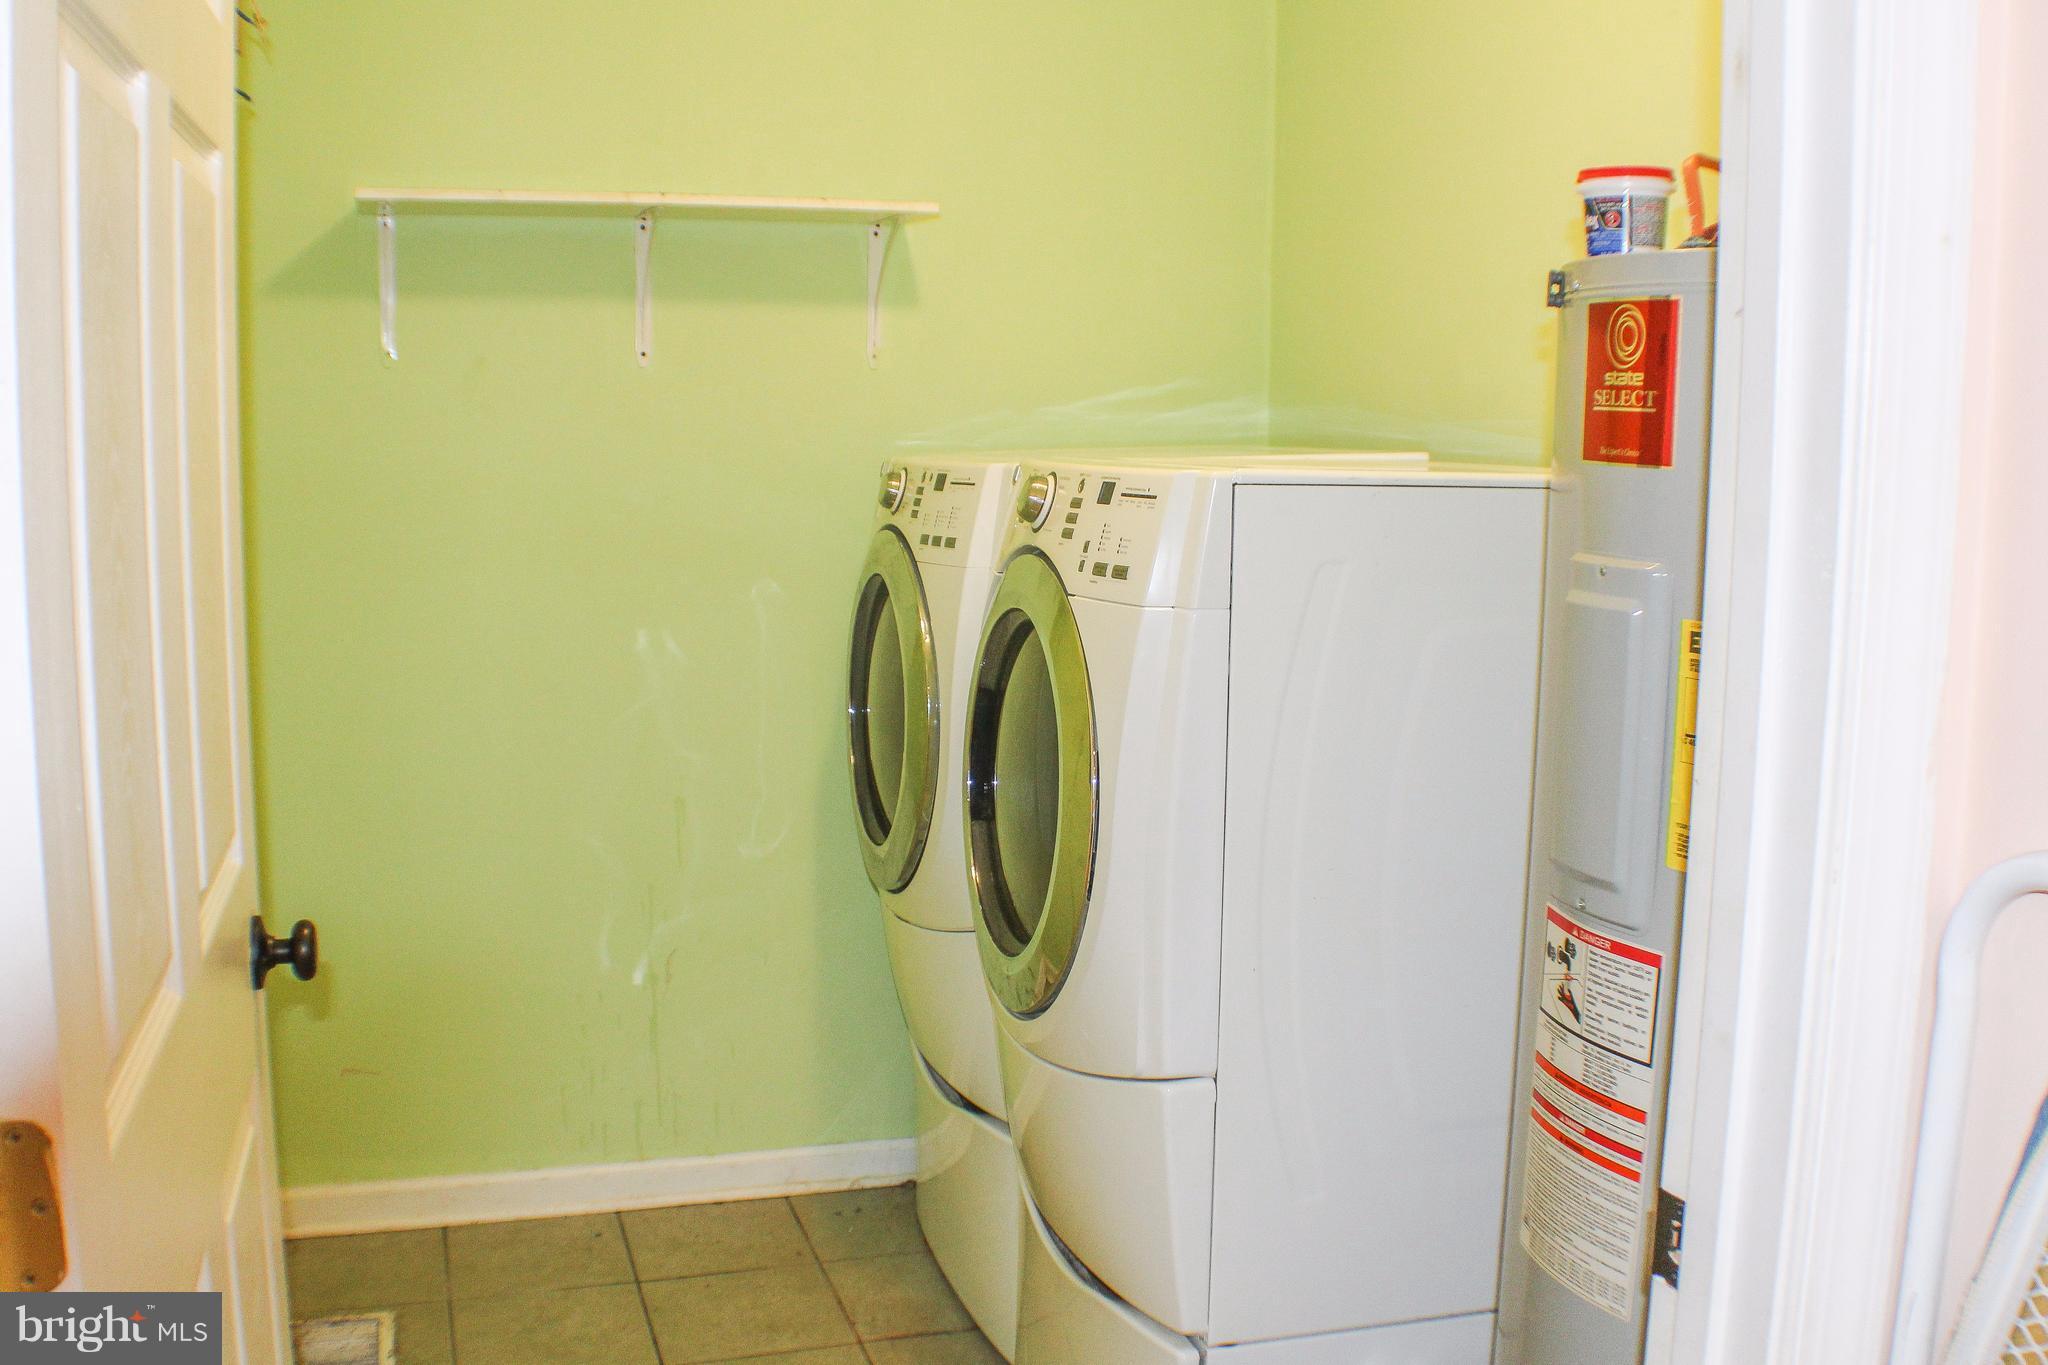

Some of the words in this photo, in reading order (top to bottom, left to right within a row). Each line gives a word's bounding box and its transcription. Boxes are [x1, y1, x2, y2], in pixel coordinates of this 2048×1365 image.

[1604, 370, 1644, 386] state
[1593, 389, 1657, 407] SELECT
[1578, 930, 1612, 951] DANGER
